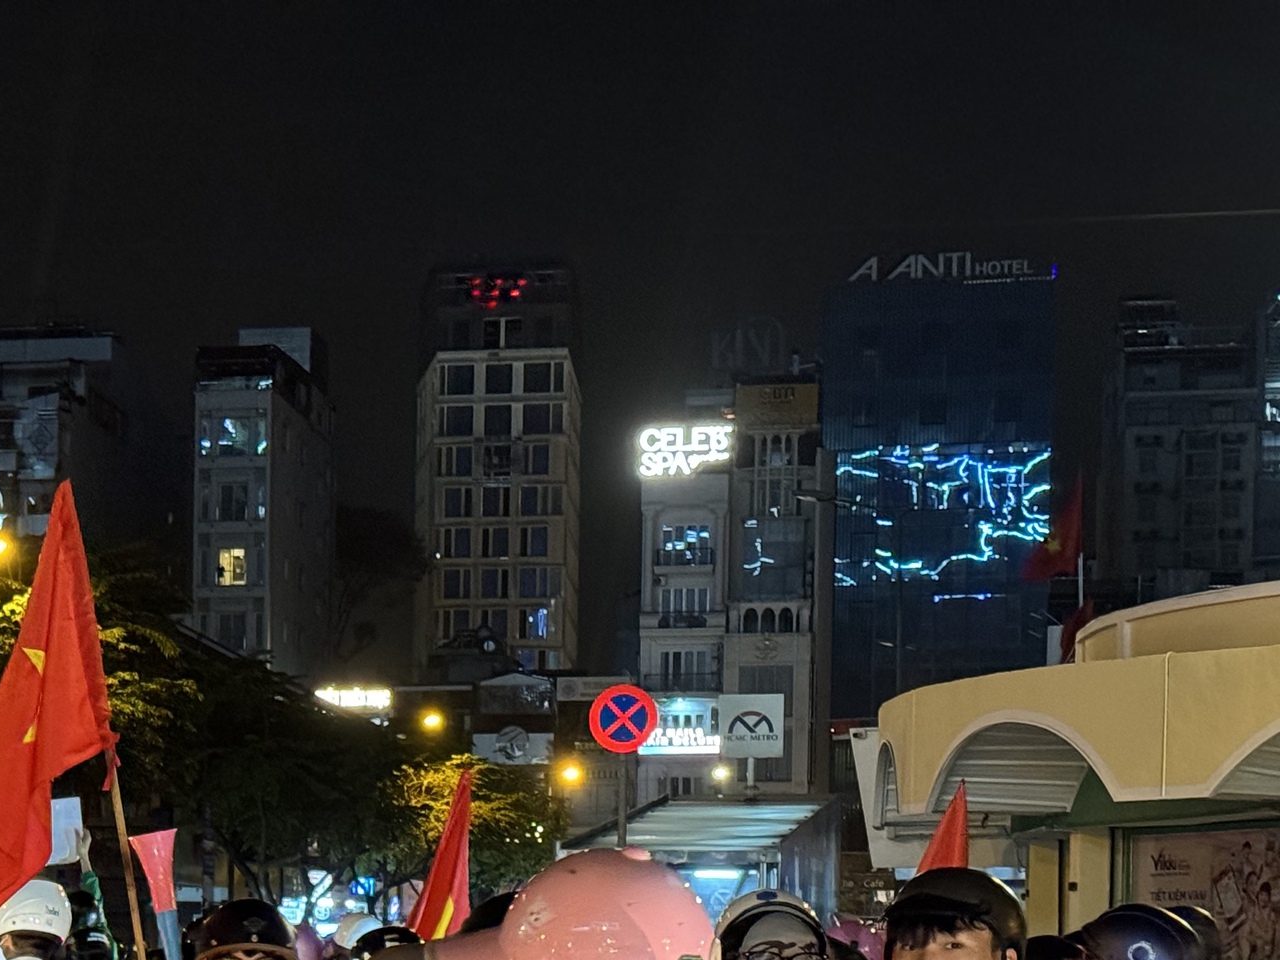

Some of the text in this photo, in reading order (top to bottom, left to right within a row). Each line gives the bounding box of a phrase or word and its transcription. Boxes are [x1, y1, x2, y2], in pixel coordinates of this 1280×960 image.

[886, 251, 971, 280] ANTI
[975, 259, 1034, 276] HOTEL
[639, 451, 691, 477] SPA
[749, 733, 779, 742] METRO
